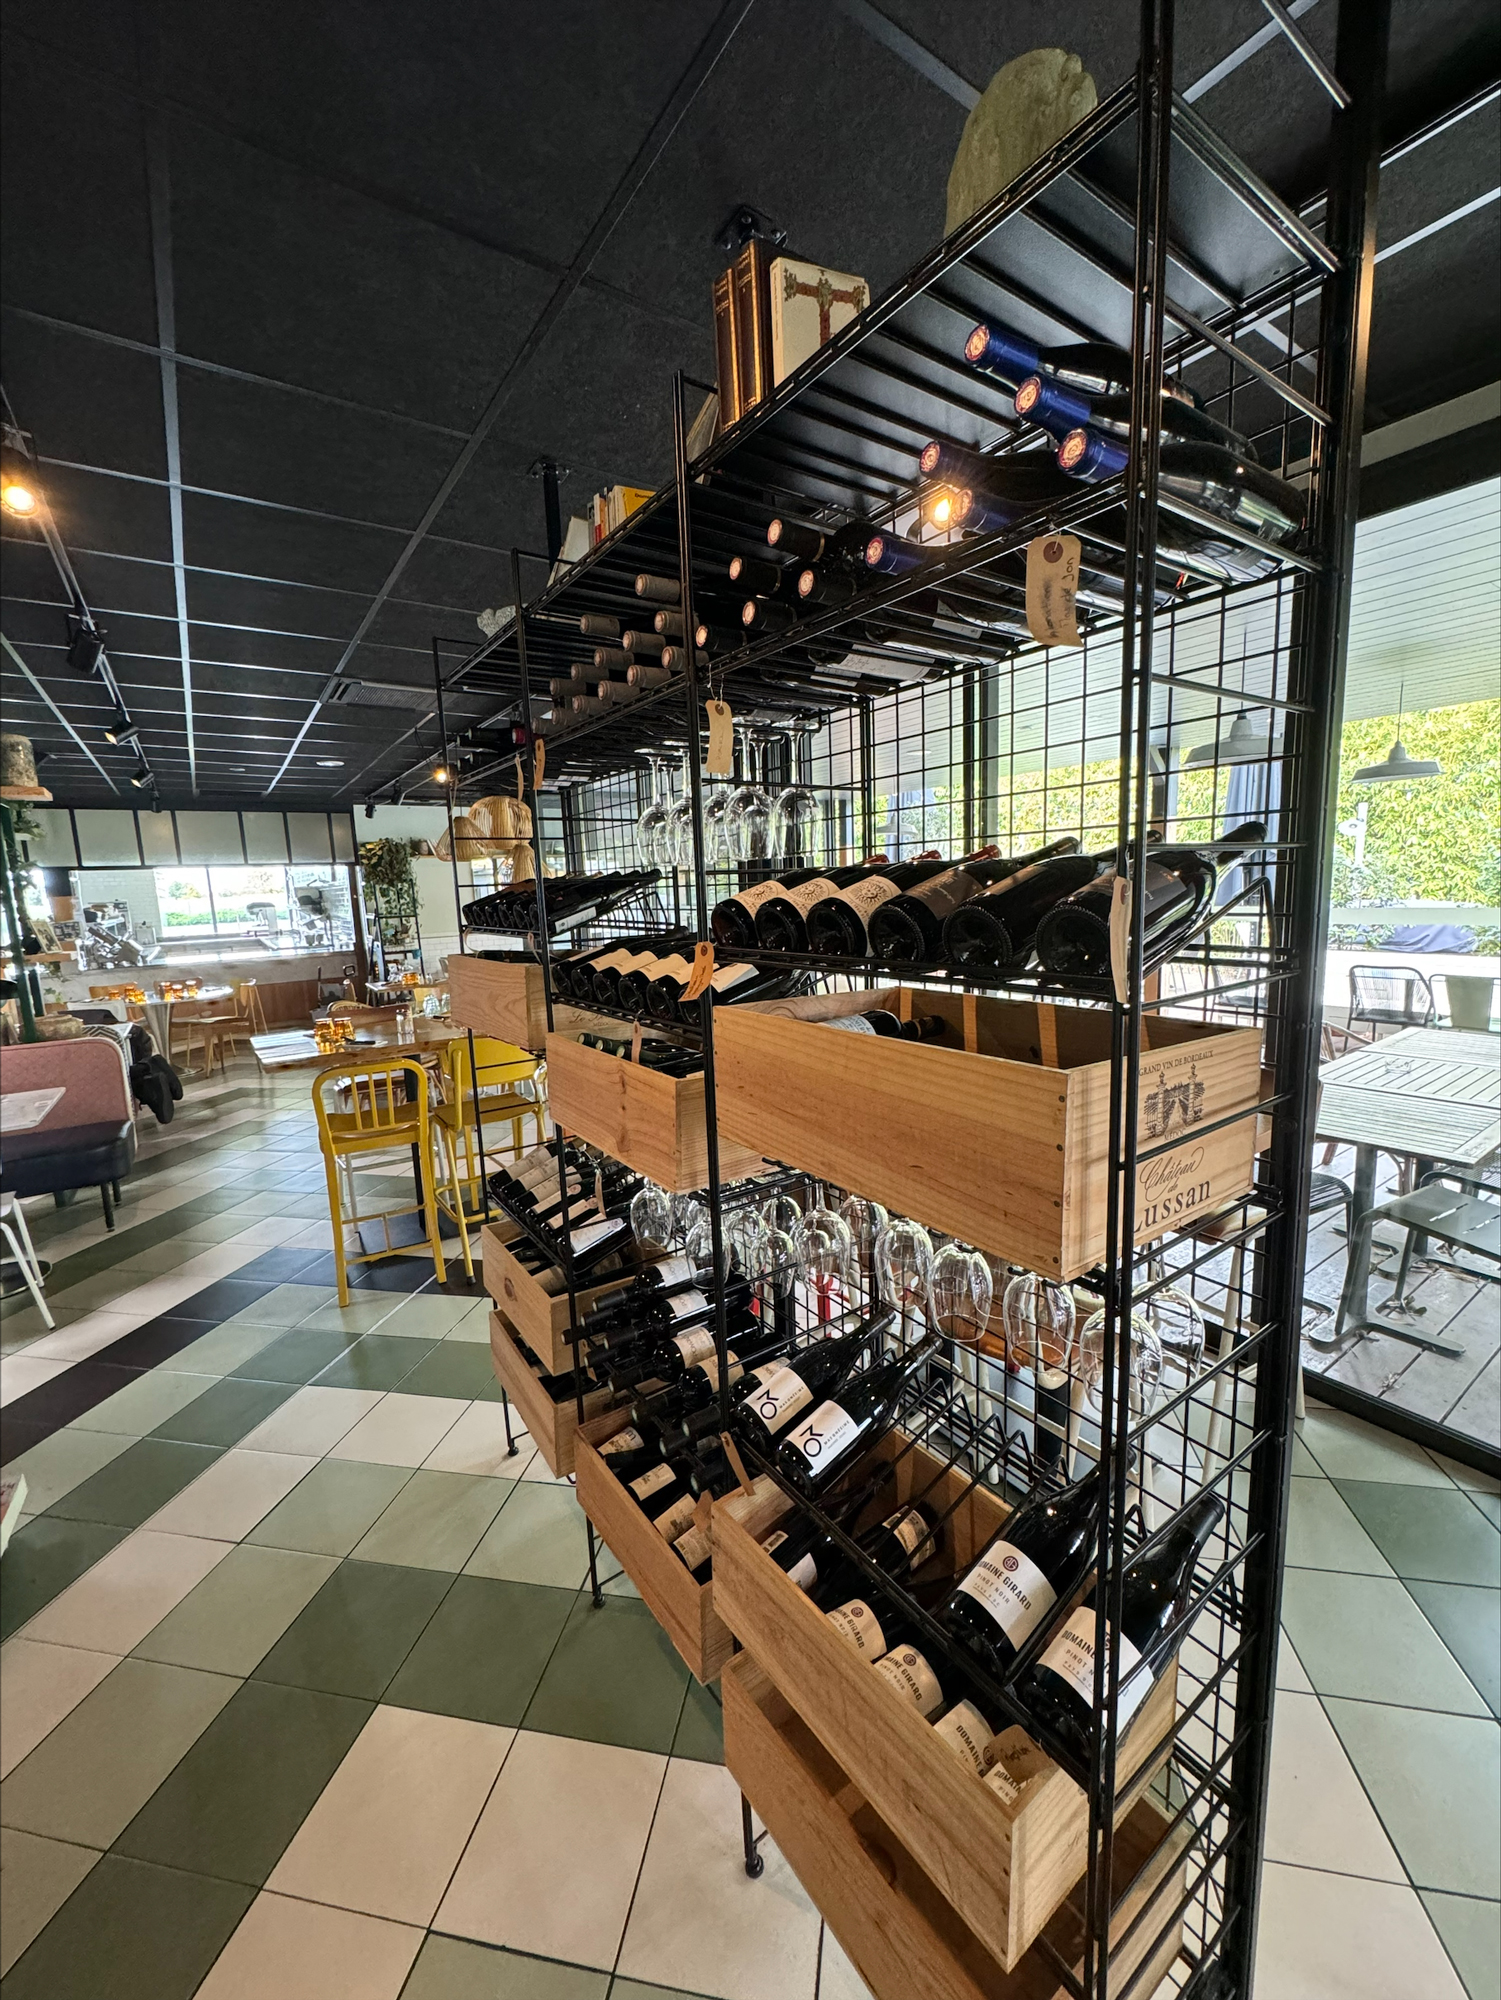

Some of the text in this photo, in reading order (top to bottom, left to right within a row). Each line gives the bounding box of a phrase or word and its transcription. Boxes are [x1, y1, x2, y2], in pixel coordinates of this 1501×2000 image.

[1139, 1050, 1214, 1076] GRAND VIN DE BORDEAUX
[1139, 1146, 1204, 1202] Château
[977, 1573, 1010, 1604] PINOT NOIR
[1002, 1576, 1031, 1610] GIRARD
[847, 1619, 865, 1649] GIRARD
[1066, 1649, 1087, 1668] PINOT
[901, 1668, 923, 1701] GIRARD
